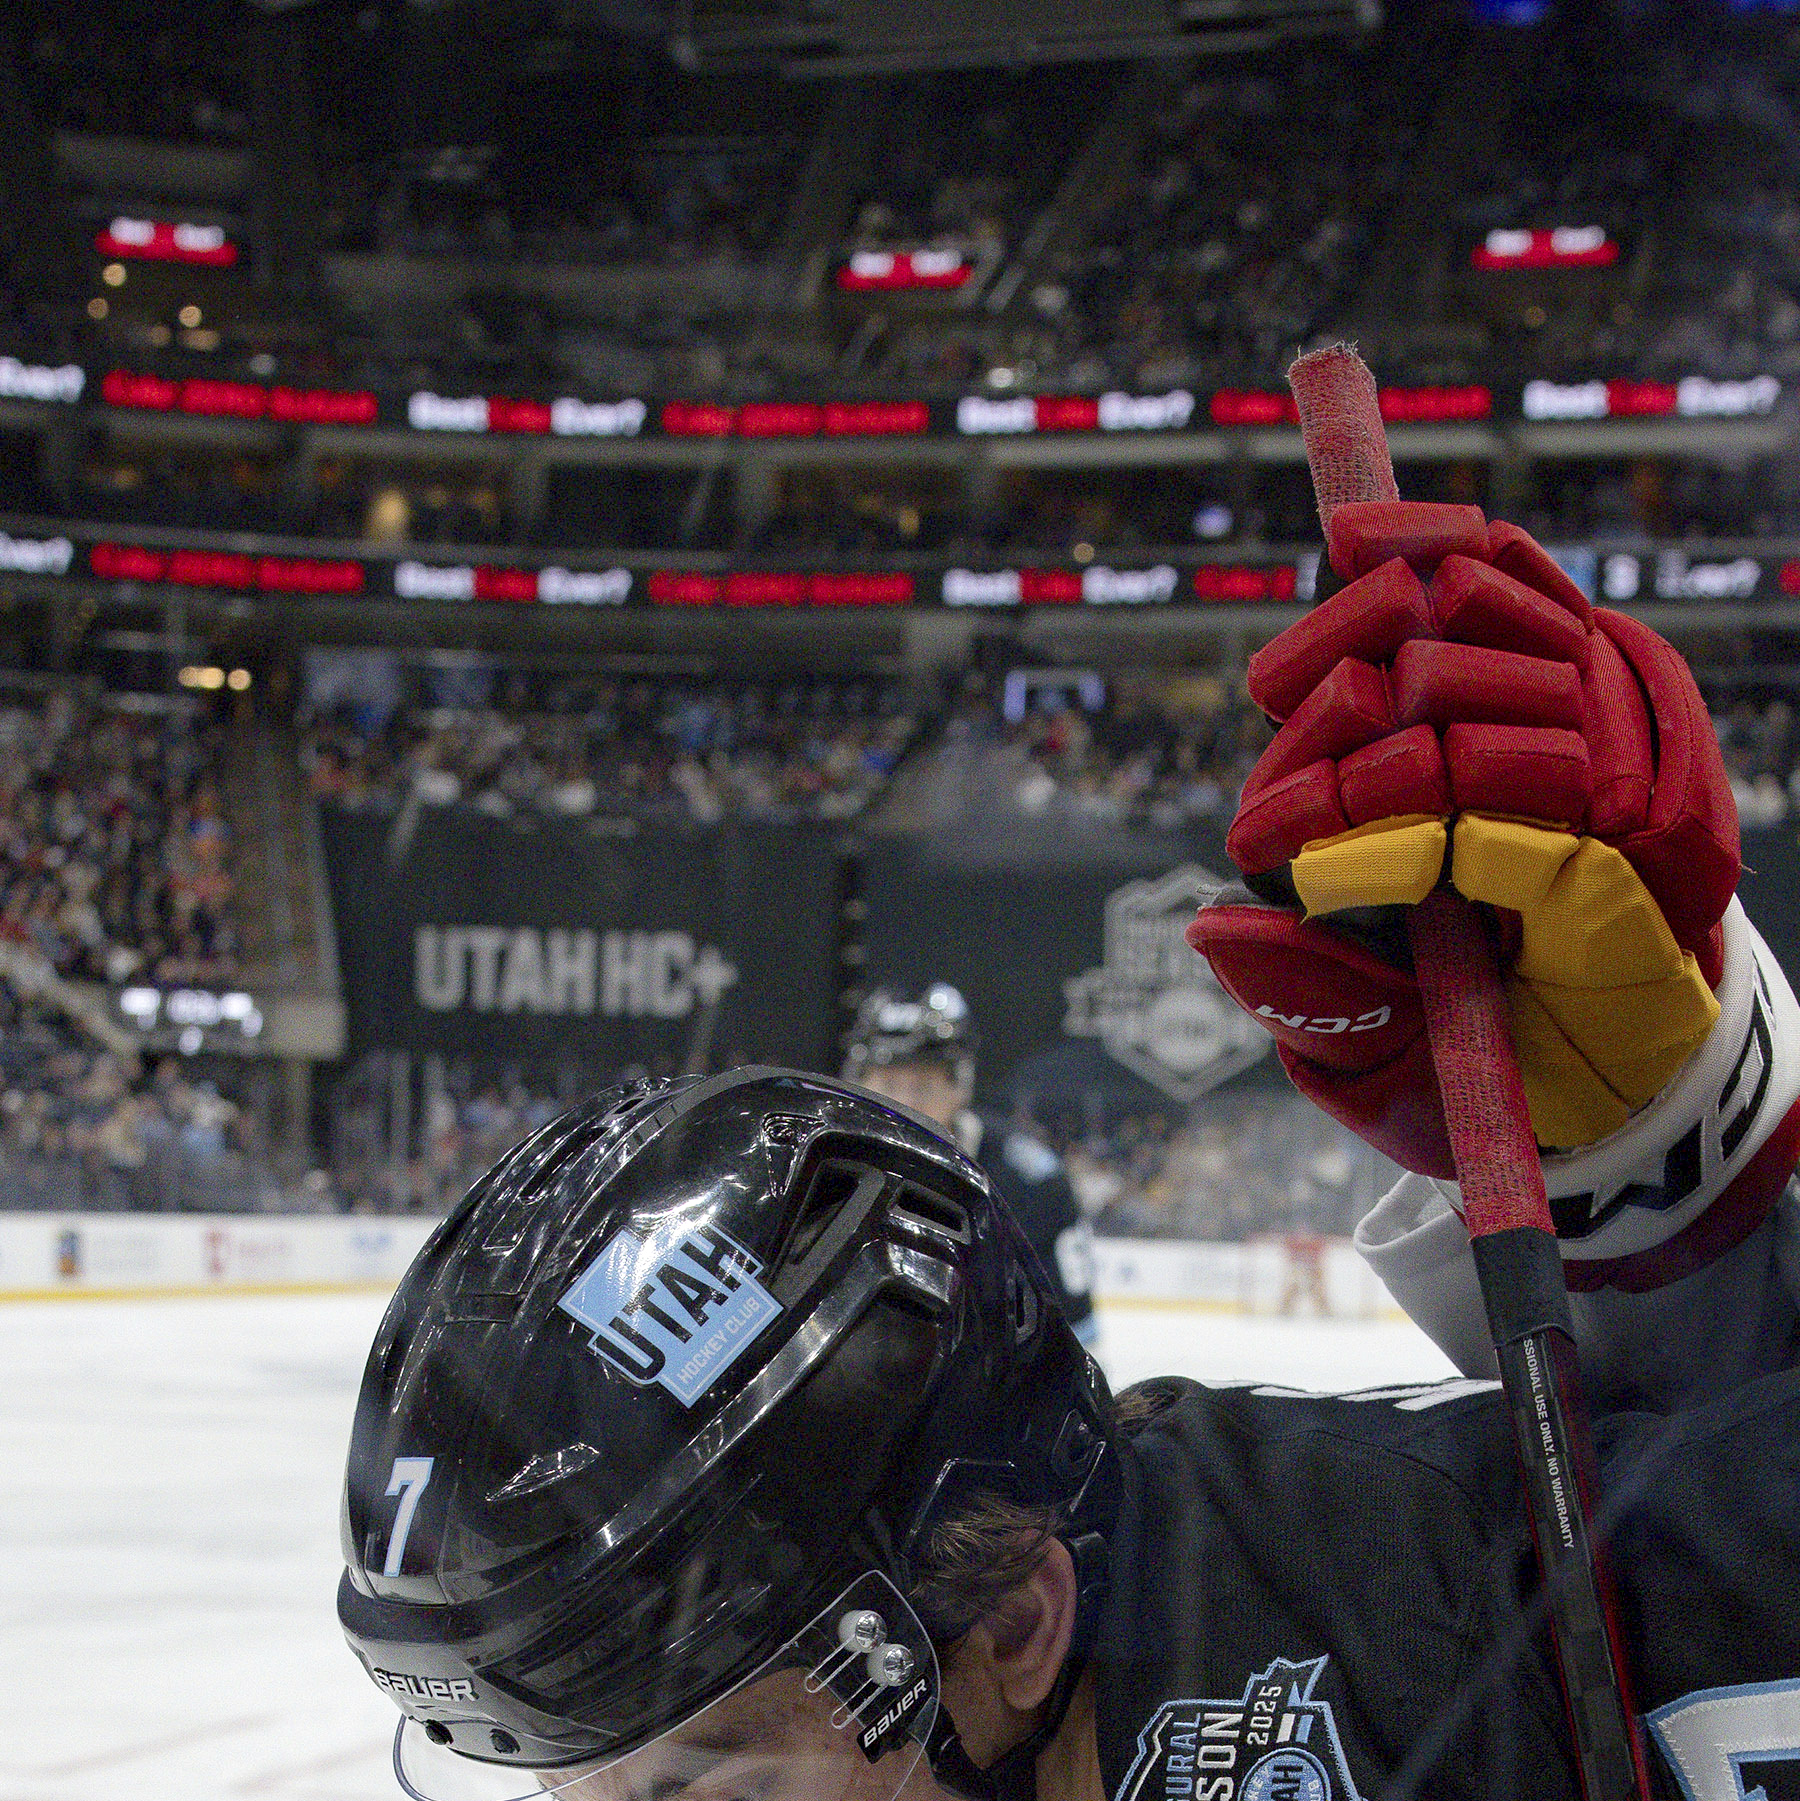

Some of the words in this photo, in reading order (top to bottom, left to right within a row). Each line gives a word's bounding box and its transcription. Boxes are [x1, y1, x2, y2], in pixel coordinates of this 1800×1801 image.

[1255, 1005, 1391, 1033] CCM
[591, 1228, 762, 1382] UTAH
[677, 1323, 730, 1384] HOCKEY
[725, 1297, 762, 1340] CLUB
[1522, 1338, 1541, 1399] SSIONAL
[1534, 1395, 1549, 1421] USE
[1539, 1420, 1556, 1457] ONLY.
[1547, 1456, 1560, 1478] NO
[383, 1456, 436, 1577] 7
[1551, 1474, 1575, 1549] WARRANTY
[1246, 1685, 1283, 1746] 2025
